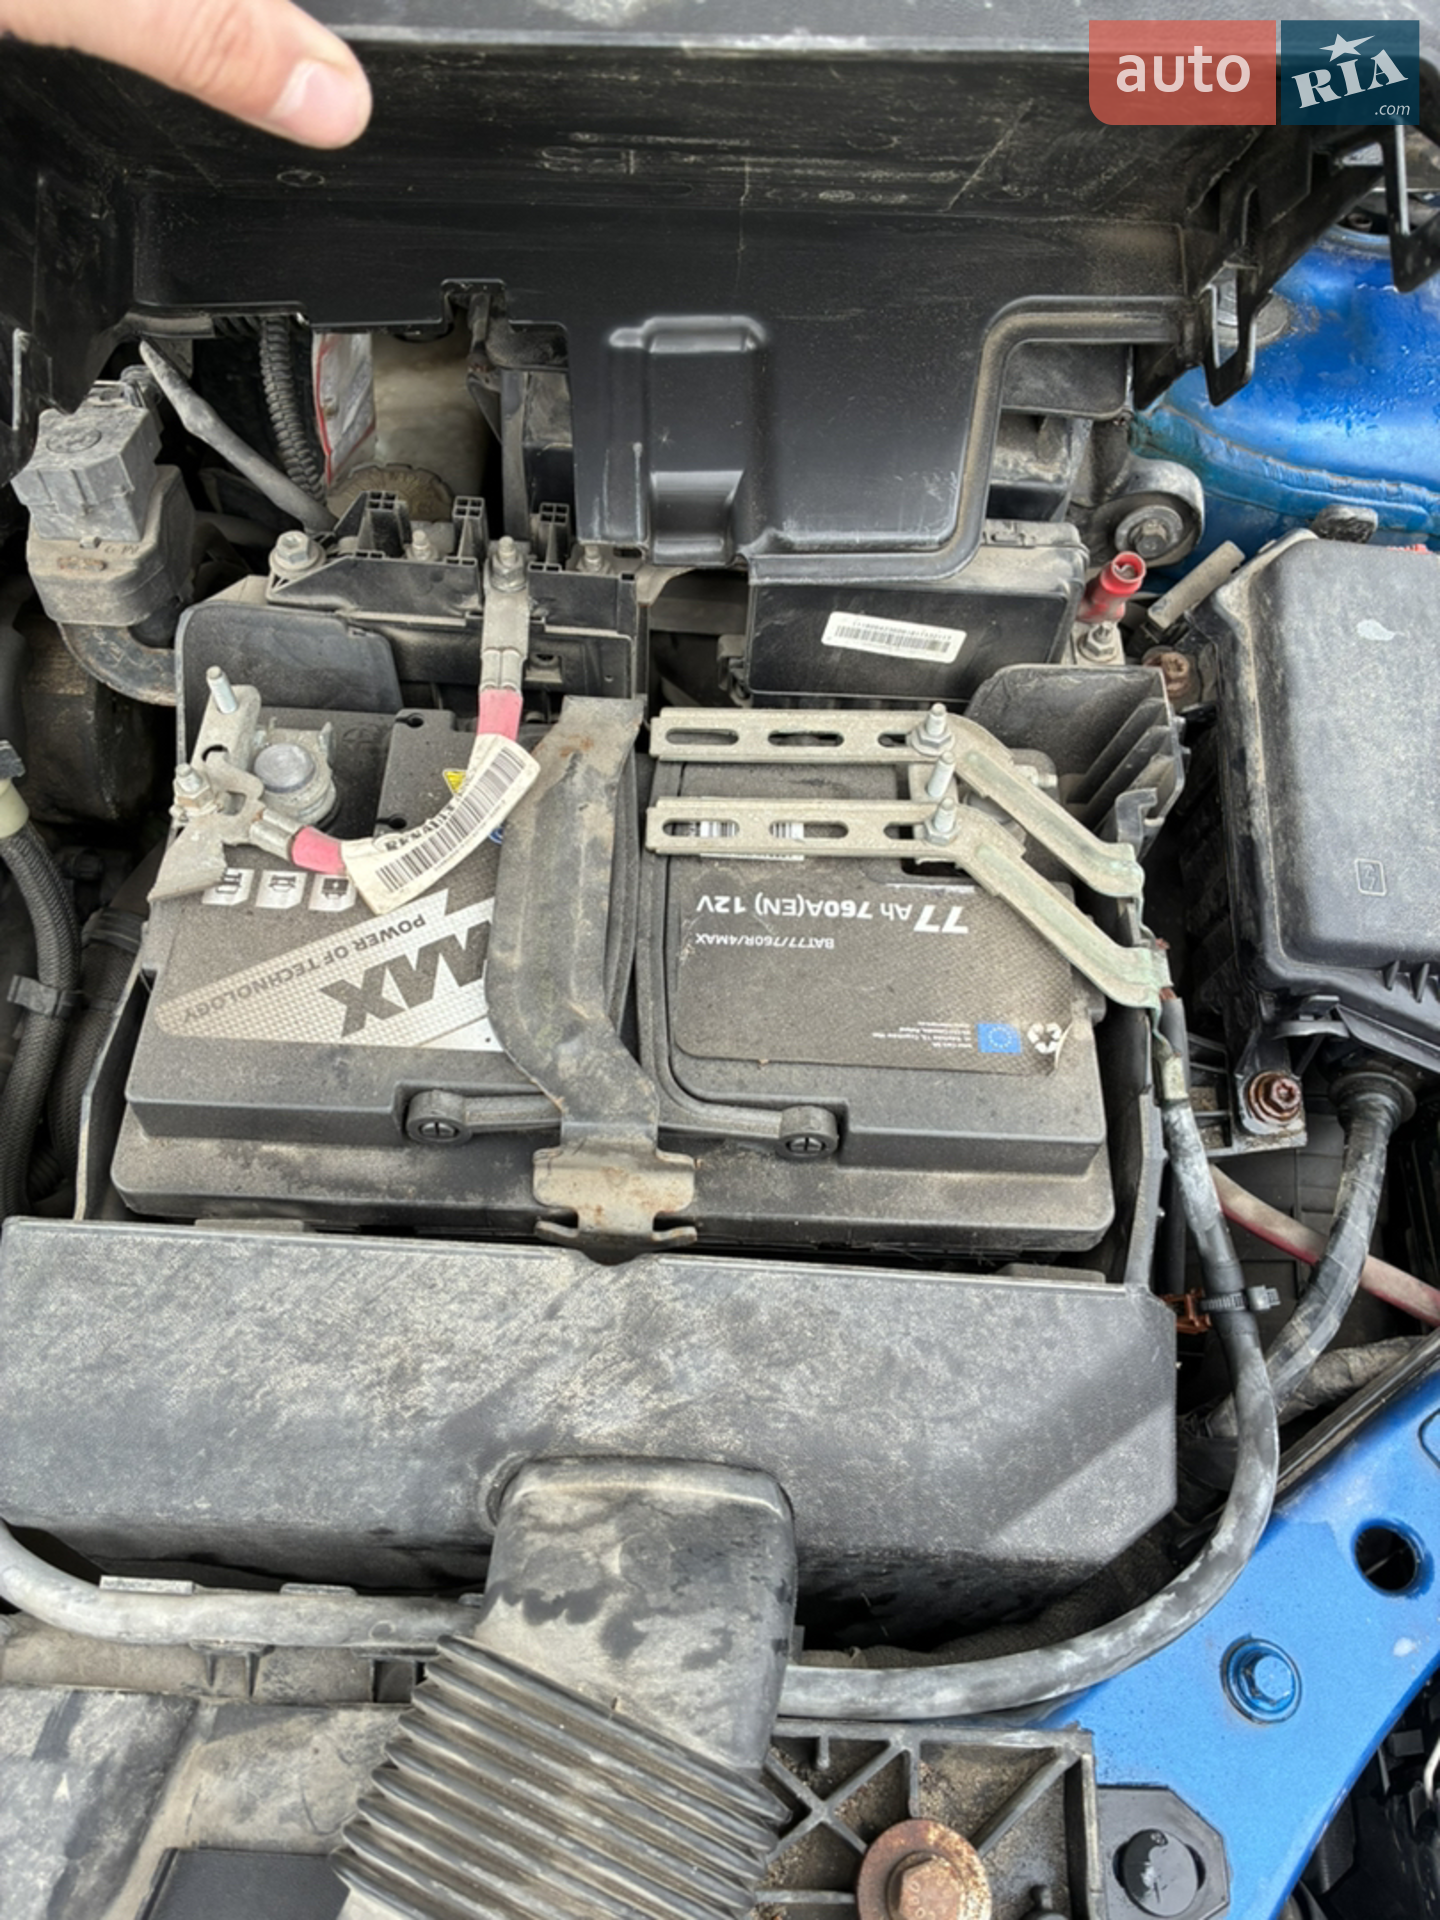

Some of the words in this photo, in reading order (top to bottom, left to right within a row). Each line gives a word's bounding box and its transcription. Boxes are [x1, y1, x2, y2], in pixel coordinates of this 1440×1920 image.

[696, 895, 747, 915] 12V
[755, 892, 873, 920] 760A(EN)
[880, 903, 913, 922] Ah
[914, 904, 969, 934] 77
[355, 913, 427, 951] POWER
[695, 932, 835, 949] BAT77/760R/4MAX
[324, 945, 350, 966] OF
[184, 958, 323, 1022] TECHNOLOGY
